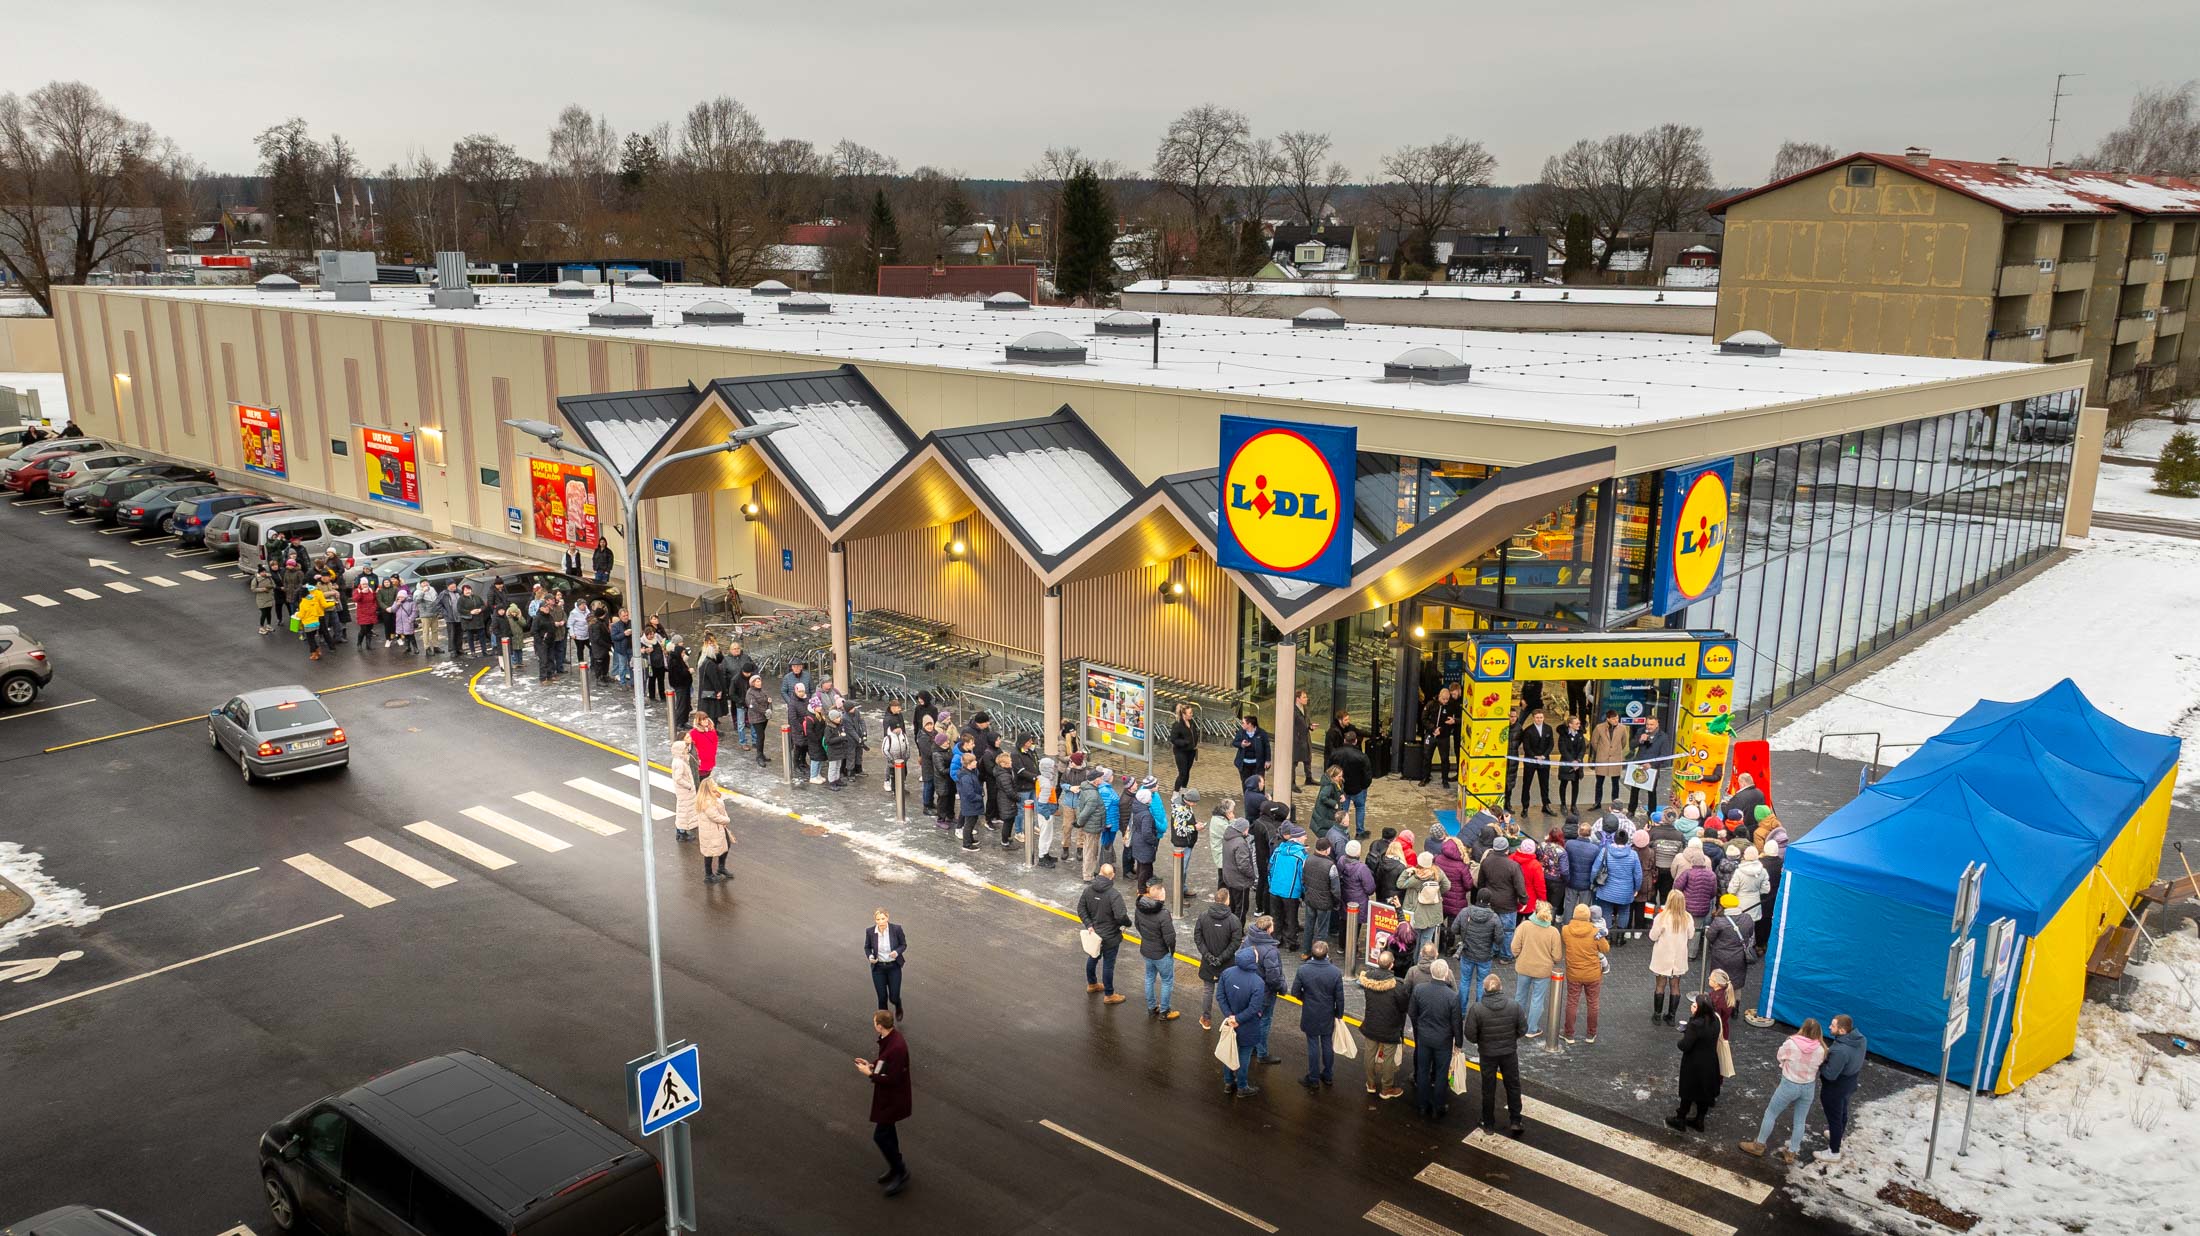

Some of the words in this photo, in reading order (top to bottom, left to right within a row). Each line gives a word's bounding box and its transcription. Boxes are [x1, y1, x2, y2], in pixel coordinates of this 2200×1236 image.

[531, 460, 554, 472] SUPER
[1231, 474, 1328, 521] LIDL
[1680, 516, 1725, 557] LIDL
[1483, 656, 1508, 666] LIDL
[1527, 654, 1598, 669] Värskelt
[1602, 653, 1686, 668] saabunud
[1706, 654, 1730, 663] LIDL
[1374, 914, 1399, 926] SUPER
